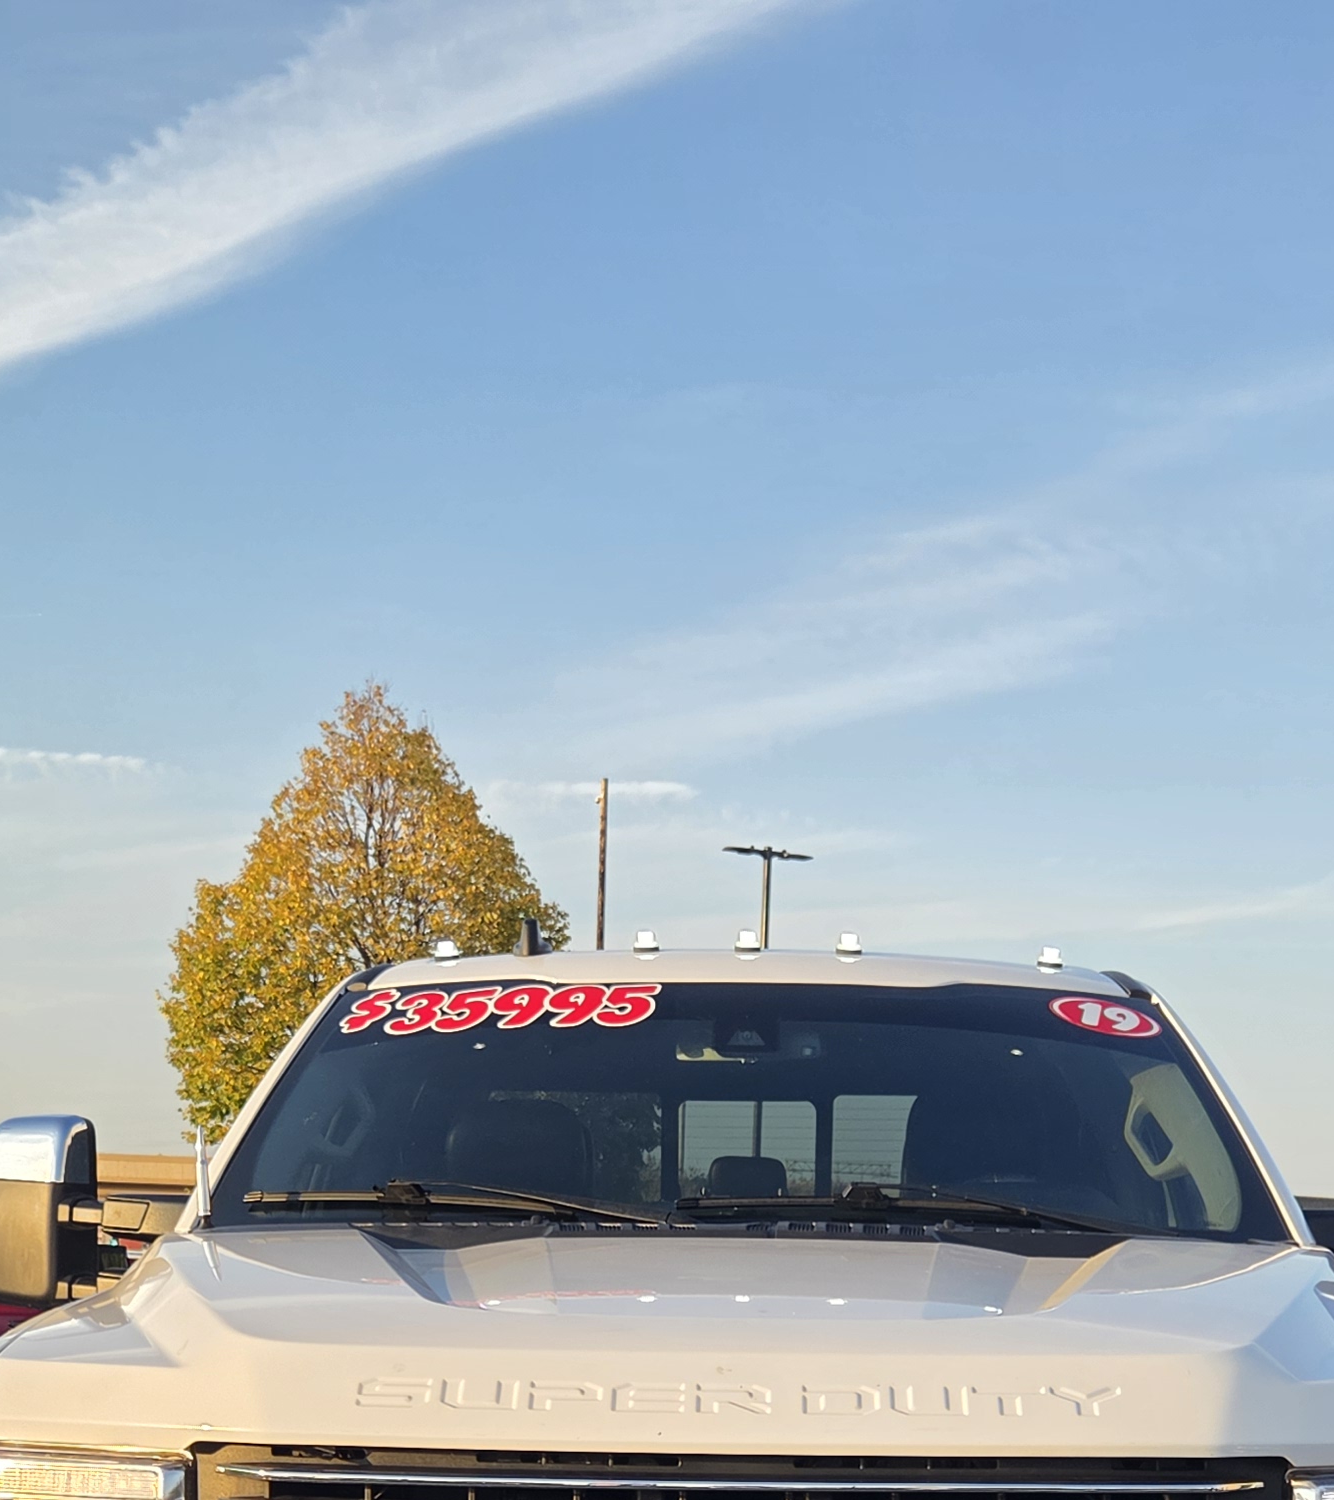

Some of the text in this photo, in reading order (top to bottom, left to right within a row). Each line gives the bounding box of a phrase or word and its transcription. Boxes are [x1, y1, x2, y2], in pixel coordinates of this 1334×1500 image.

[339, 983, 662, 1036] $35995
[1077, 1002, 1141, 1032] 19
[354, 1376, 1123, 1418] SUPER DUTY
